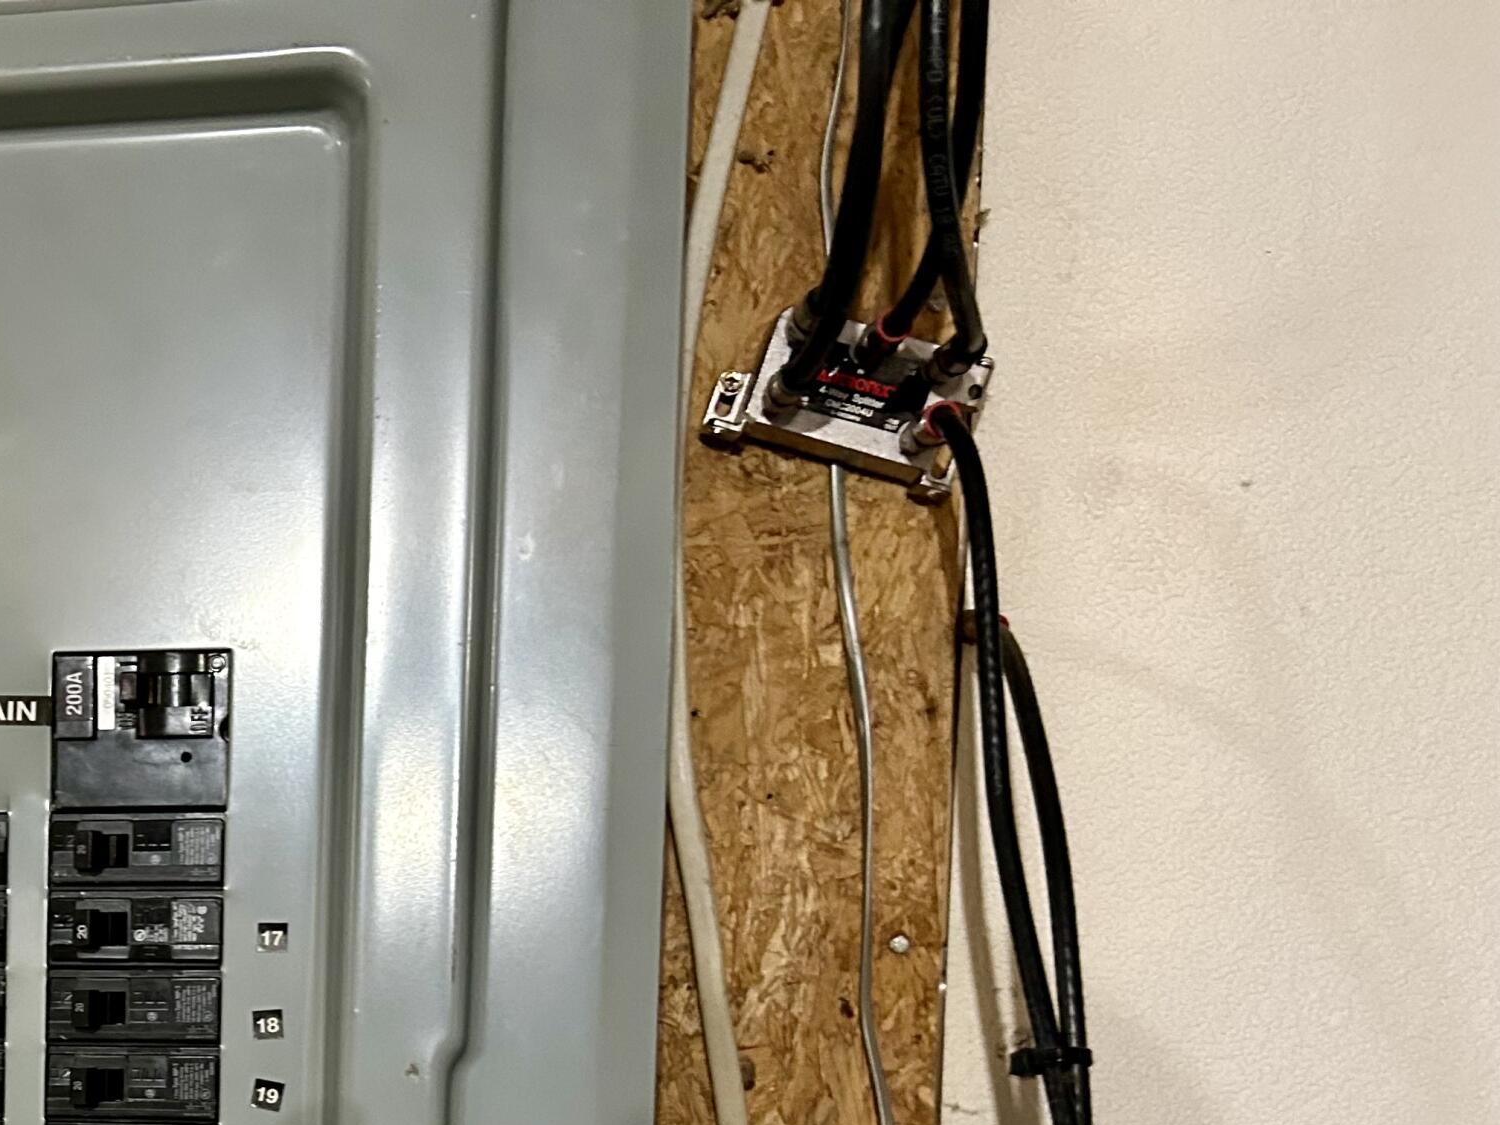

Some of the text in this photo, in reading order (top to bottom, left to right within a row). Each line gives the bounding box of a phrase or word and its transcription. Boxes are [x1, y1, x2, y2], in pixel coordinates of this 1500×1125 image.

[65, 671, 83, 716] 200A
[76, 924, 88, 940] 20
[260, 930, 285, 947] 17
[256, 1016, 281, 1035] 18
[256, 1086, 280, 1105] 19
